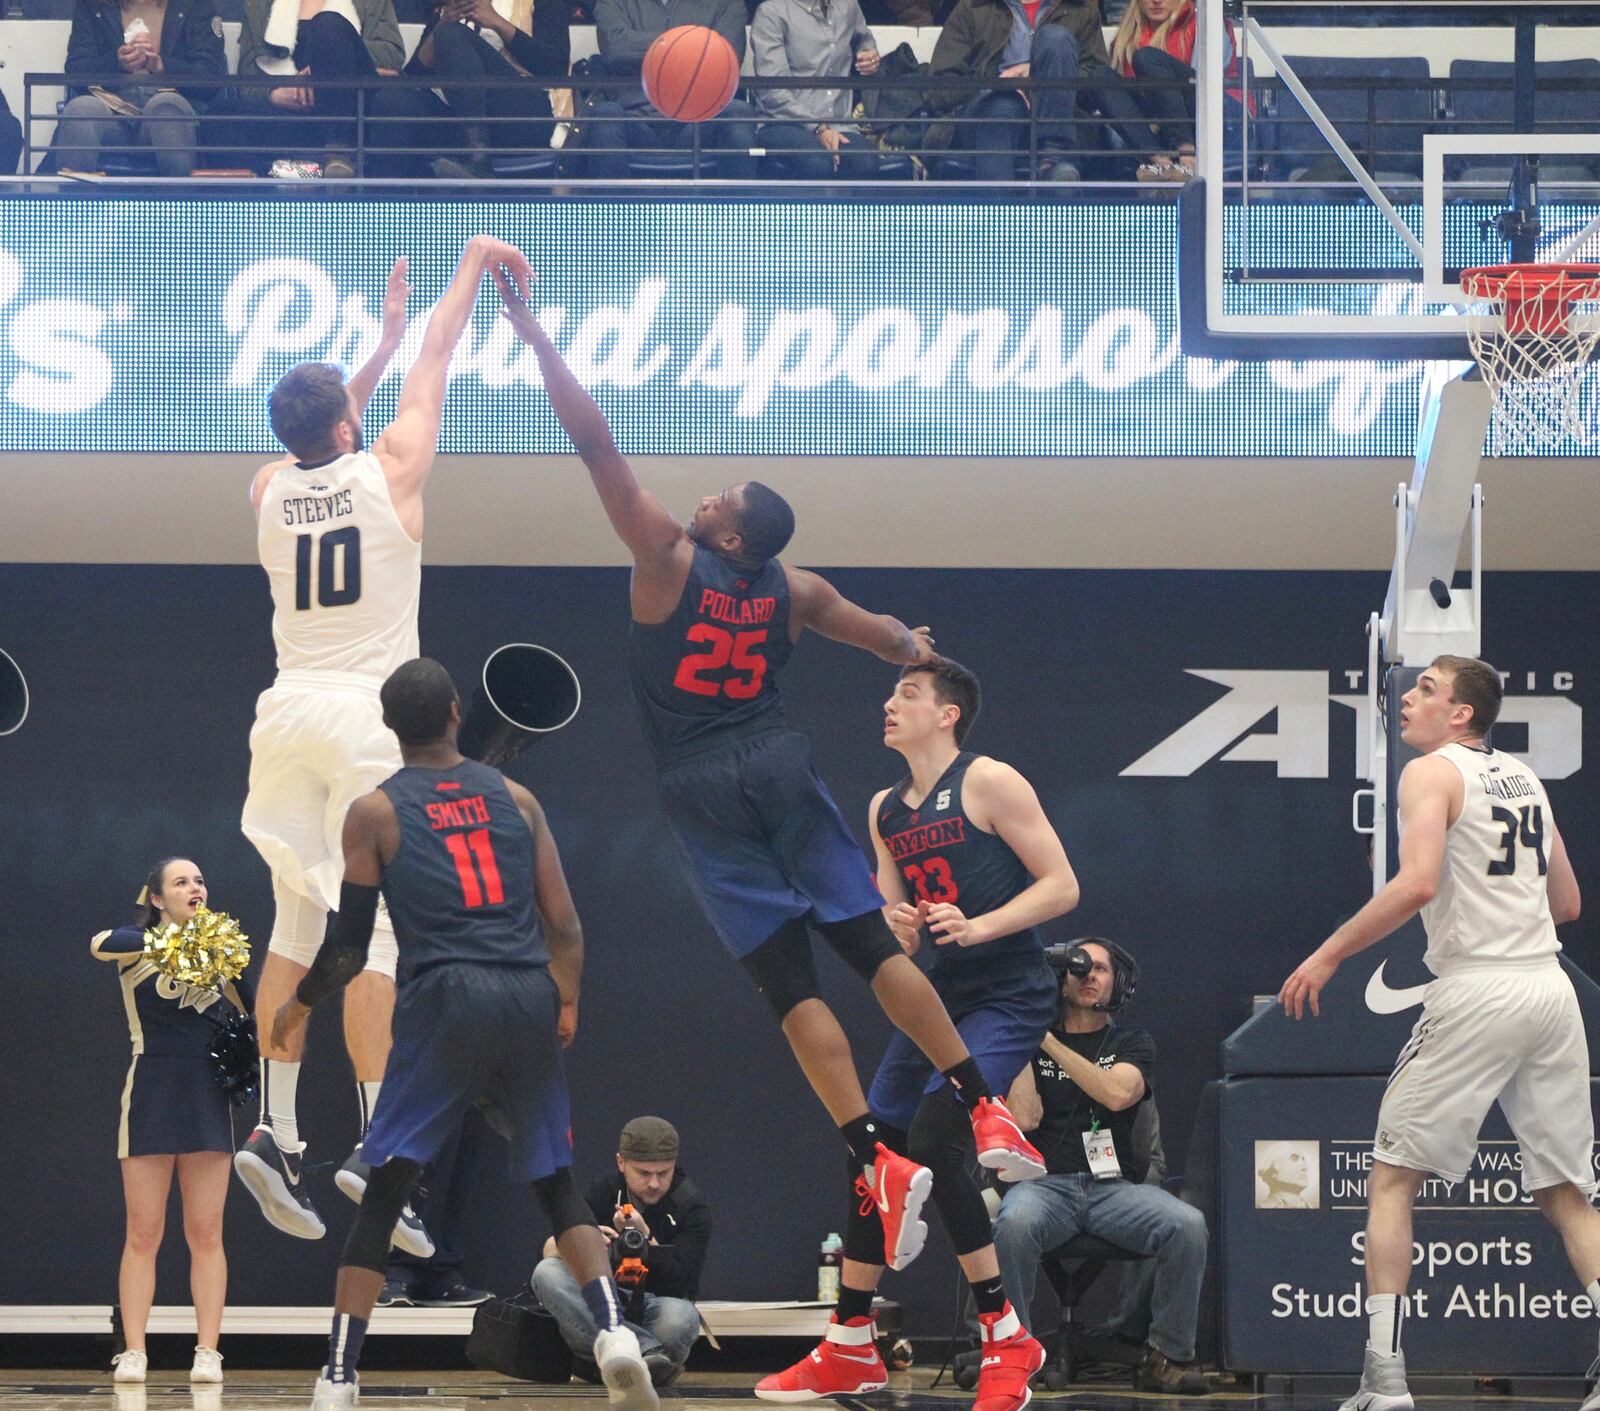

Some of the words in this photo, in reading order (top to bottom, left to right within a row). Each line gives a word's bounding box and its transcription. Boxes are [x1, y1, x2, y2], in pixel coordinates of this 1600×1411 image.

[283, 489, 353, 526] STEEVES
[296, 526, 361, 611] 10
[698, 588, 777, 625] POLLARD
[673, 622, 769, 699] 25
[426, 795, 491, 830] SMITH
[935, 788, 952, 811] 5
[1487, 805, 1547, 876] 34
[445, 828, 505, 908] 11
[904, 857, 958, 908] 33
[1350, 1231, 1532, 1277] Sports
[1271, 1283, 1429, 1318] Studt
